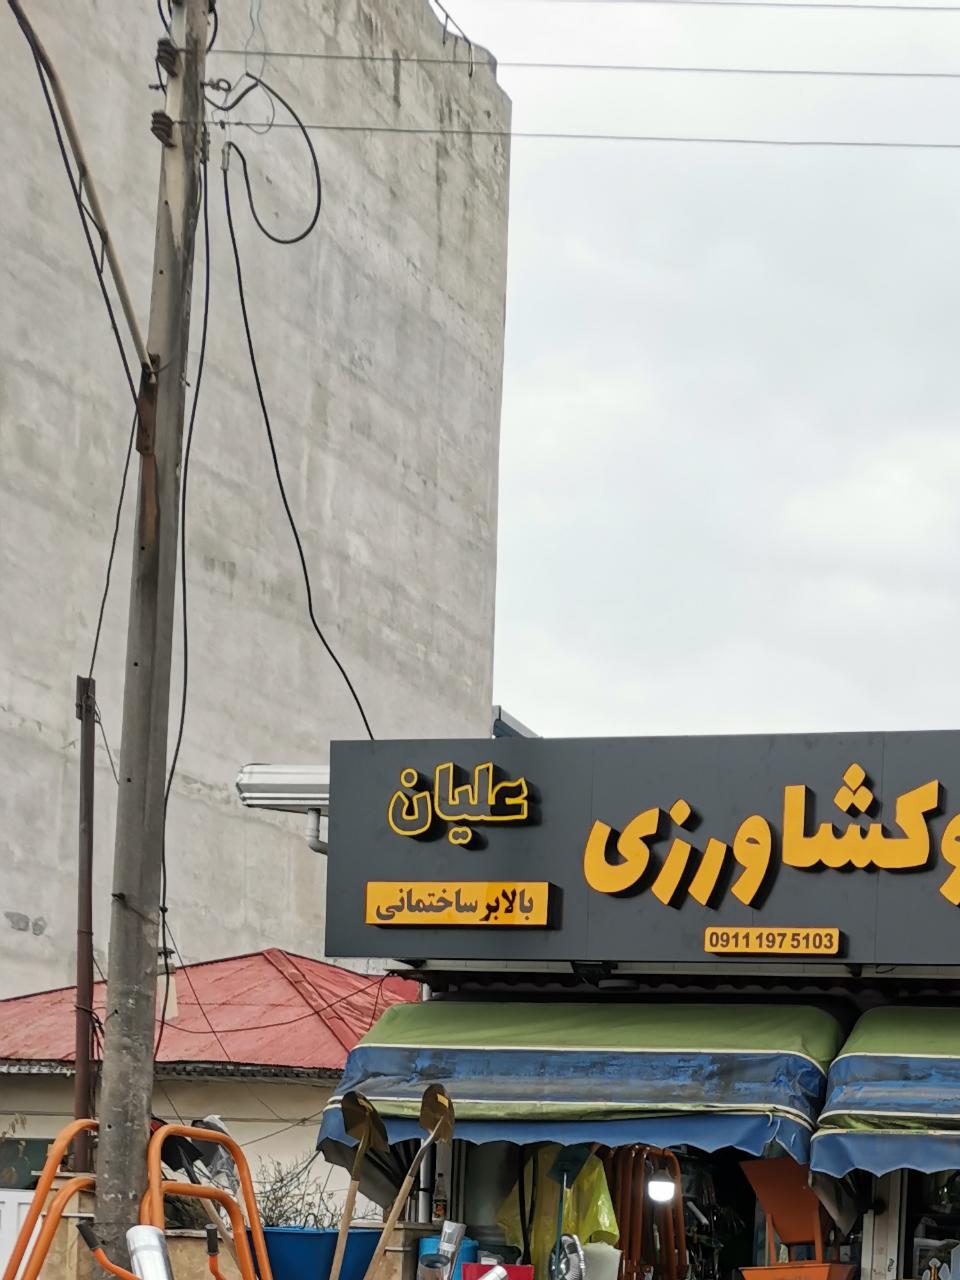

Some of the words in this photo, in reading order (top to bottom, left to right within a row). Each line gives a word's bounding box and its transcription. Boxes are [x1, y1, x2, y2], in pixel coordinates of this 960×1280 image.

[387, 761, 529, 845] علیان
[375, 888, 478, 921] ساختمانی
[479, 888, 534, 922] بالابر
